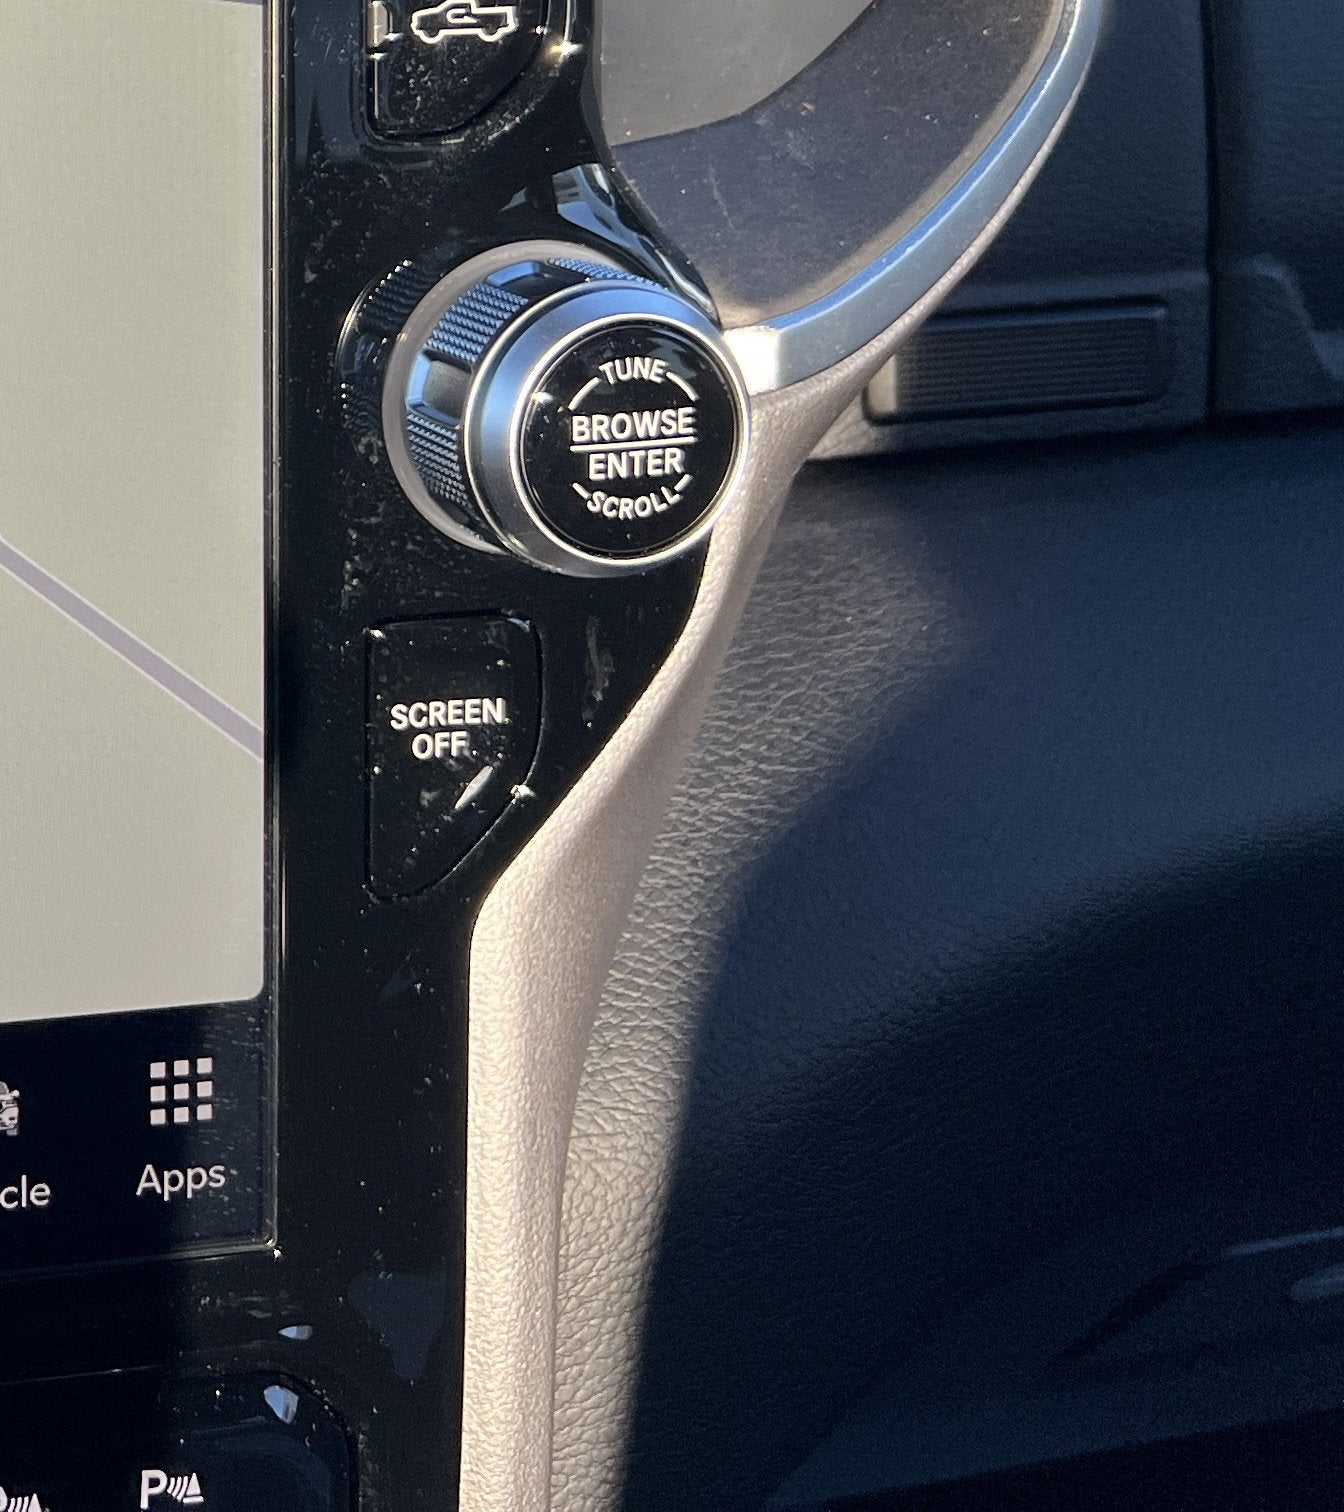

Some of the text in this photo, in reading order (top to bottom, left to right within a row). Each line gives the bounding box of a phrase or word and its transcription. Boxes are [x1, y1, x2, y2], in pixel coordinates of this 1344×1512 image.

[599, 357, 668, 385] TUNE
[571, 408, 696, 444] BROWSE
[587, 448, 684, 480] ENTER
[587, 486, 682, 519] SCROLL
[391, 698, 505, 729] SCREEN
[412, 731, 469, 759] OFF
[136, 1164, 225, 1201] Apps
